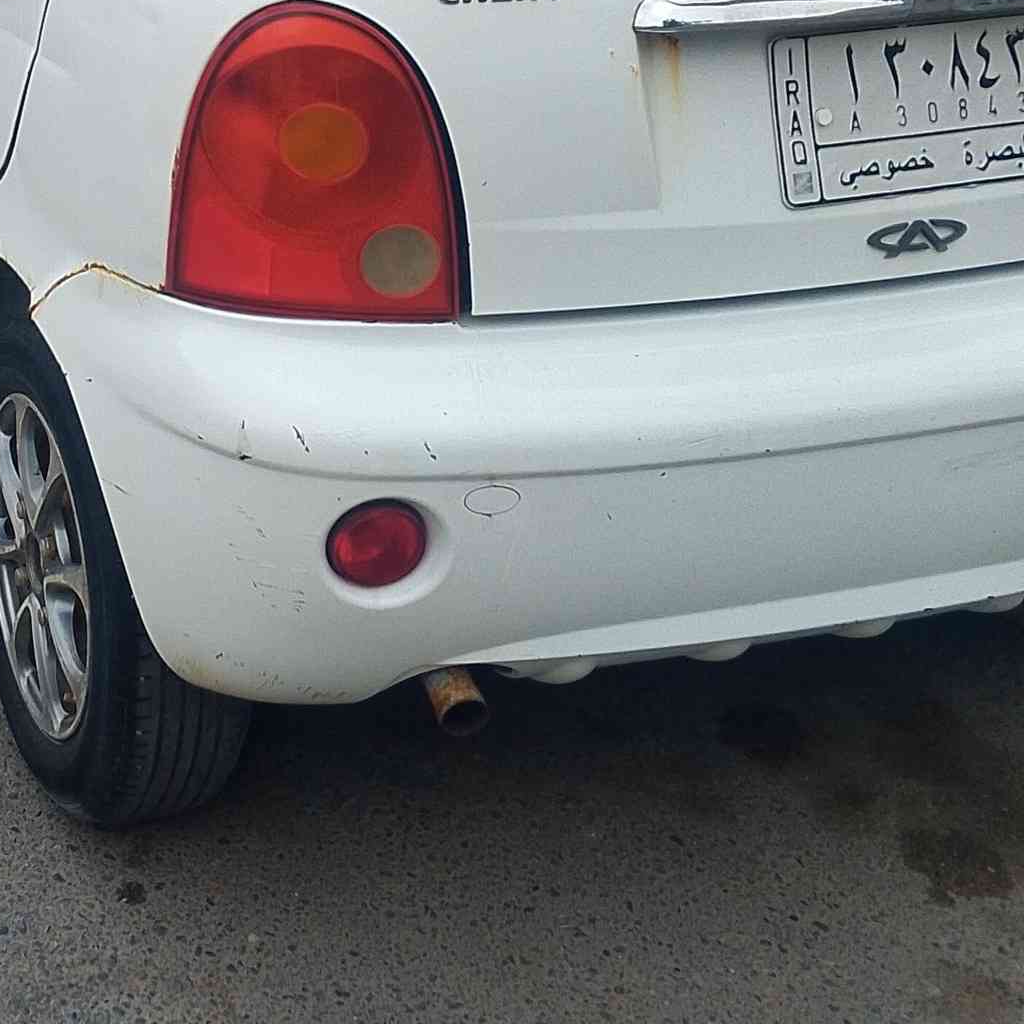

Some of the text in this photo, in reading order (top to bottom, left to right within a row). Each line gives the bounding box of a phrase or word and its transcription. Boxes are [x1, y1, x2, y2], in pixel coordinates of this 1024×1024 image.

[784, 48, 808, 165] IRAQ
[839, 135, 1024, 190] بصرة خصوصي
